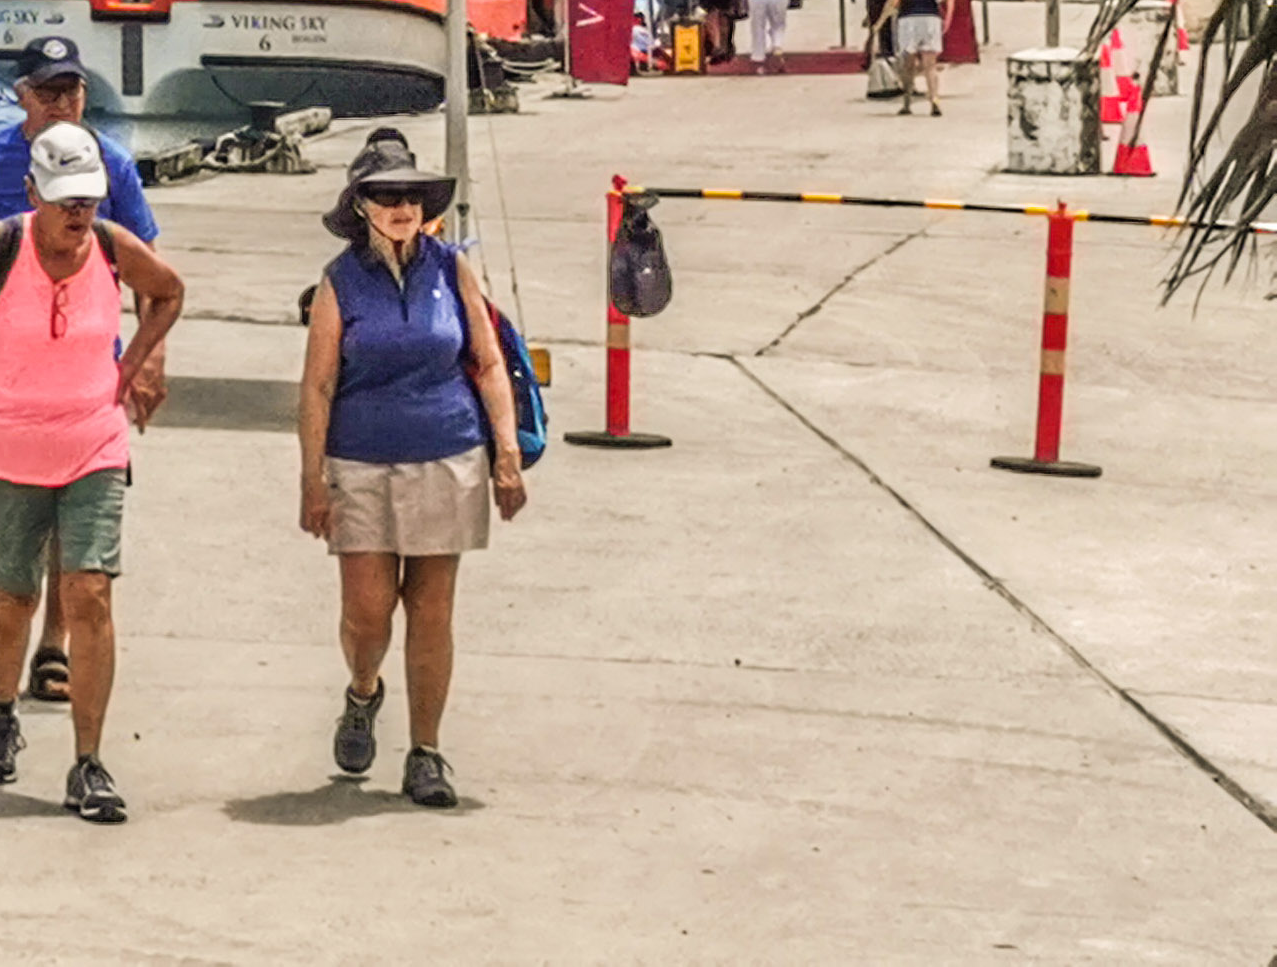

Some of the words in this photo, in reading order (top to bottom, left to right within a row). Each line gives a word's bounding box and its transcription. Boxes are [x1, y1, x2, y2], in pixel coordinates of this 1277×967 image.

[231, 14, 295, 30] VIKING
[300, 15, 327, 31] SKY
[3, 29, 13, 44] 6
[258, 34, 271, 51] 6
